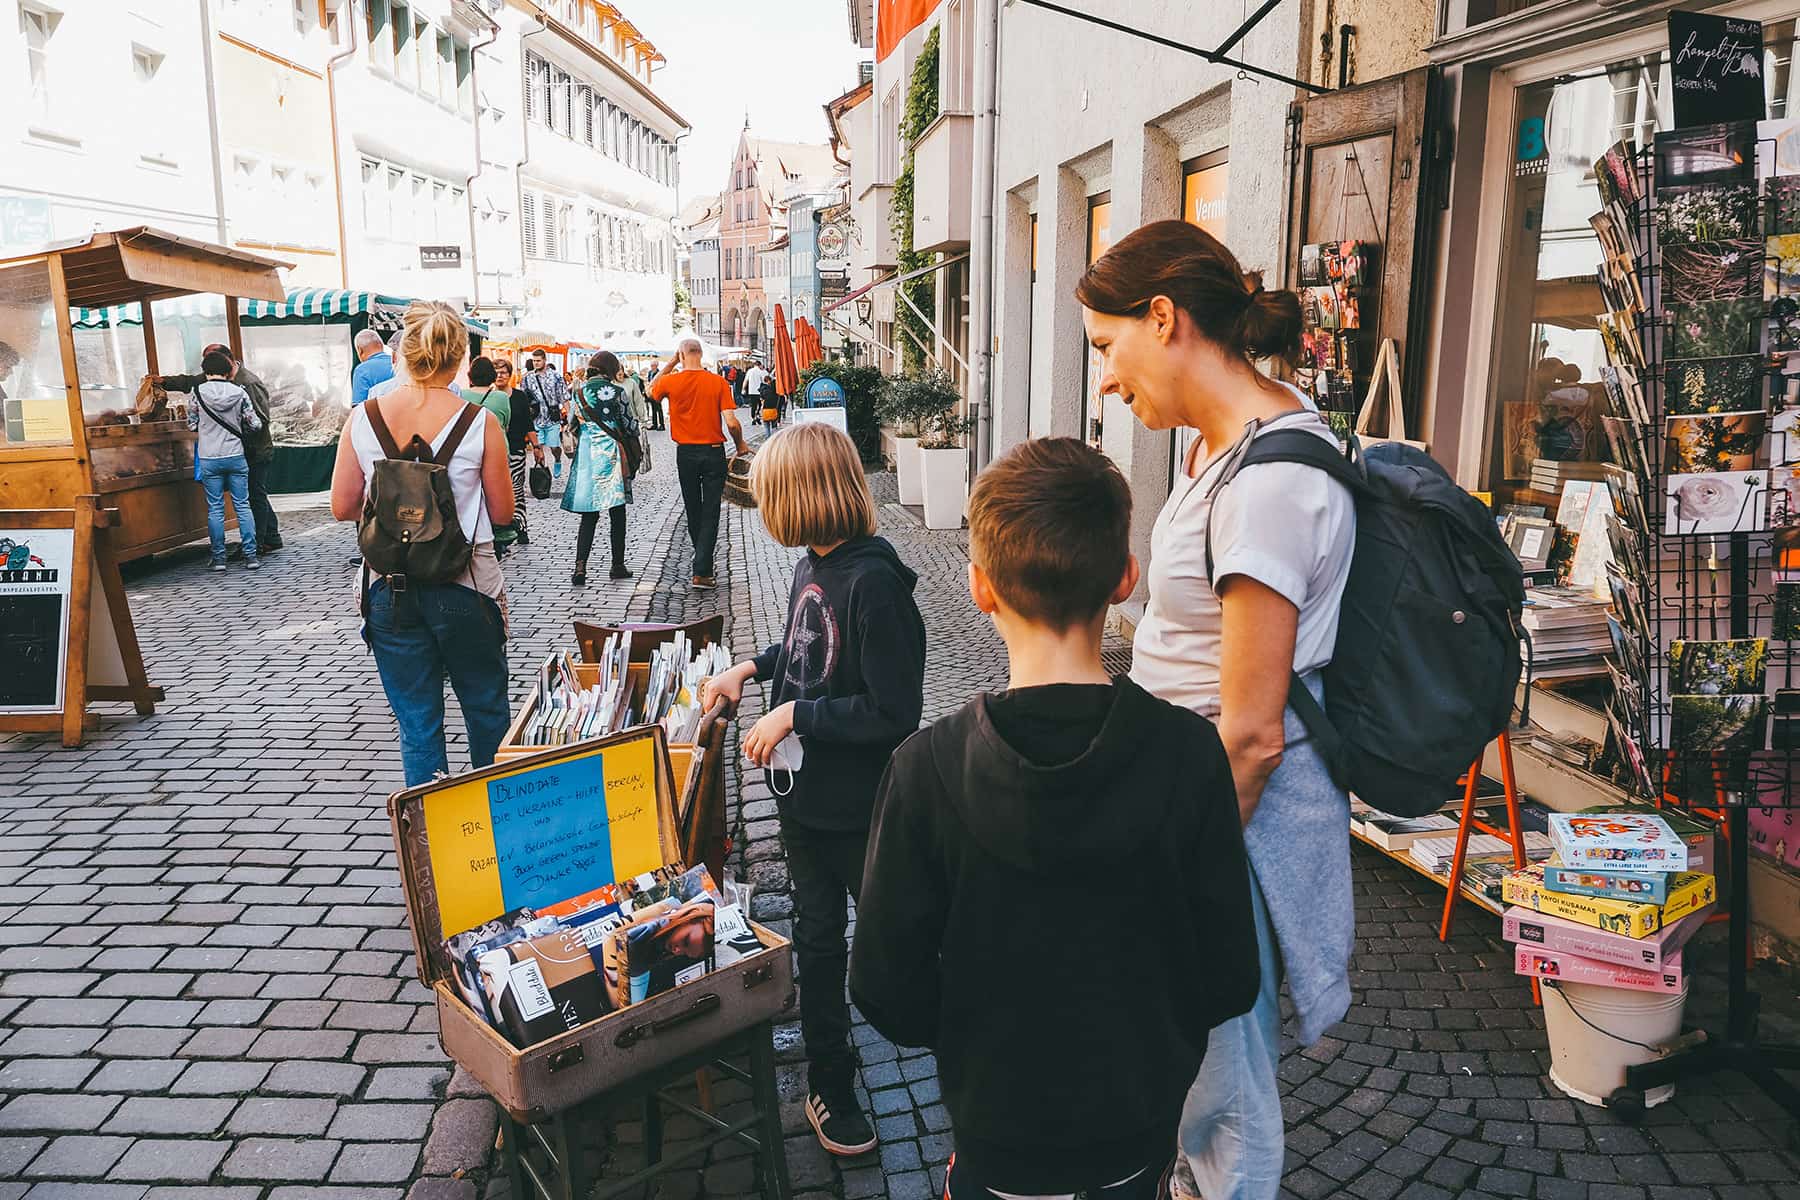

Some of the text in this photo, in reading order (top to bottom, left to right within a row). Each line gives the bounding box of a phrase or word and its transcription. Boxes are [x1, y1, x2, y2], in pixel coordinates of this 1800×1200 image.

[1517, 116, 1545, 160] B
[493, 813, 511, 825] DIE
[607, 774, 642, 791] BERLIN
[1539, 894, 1597, 915] YAYOI KUSAMAS
[1558, 905, 1577, 916] WELT
[1614, 977, 1637, 985] FEMALE
